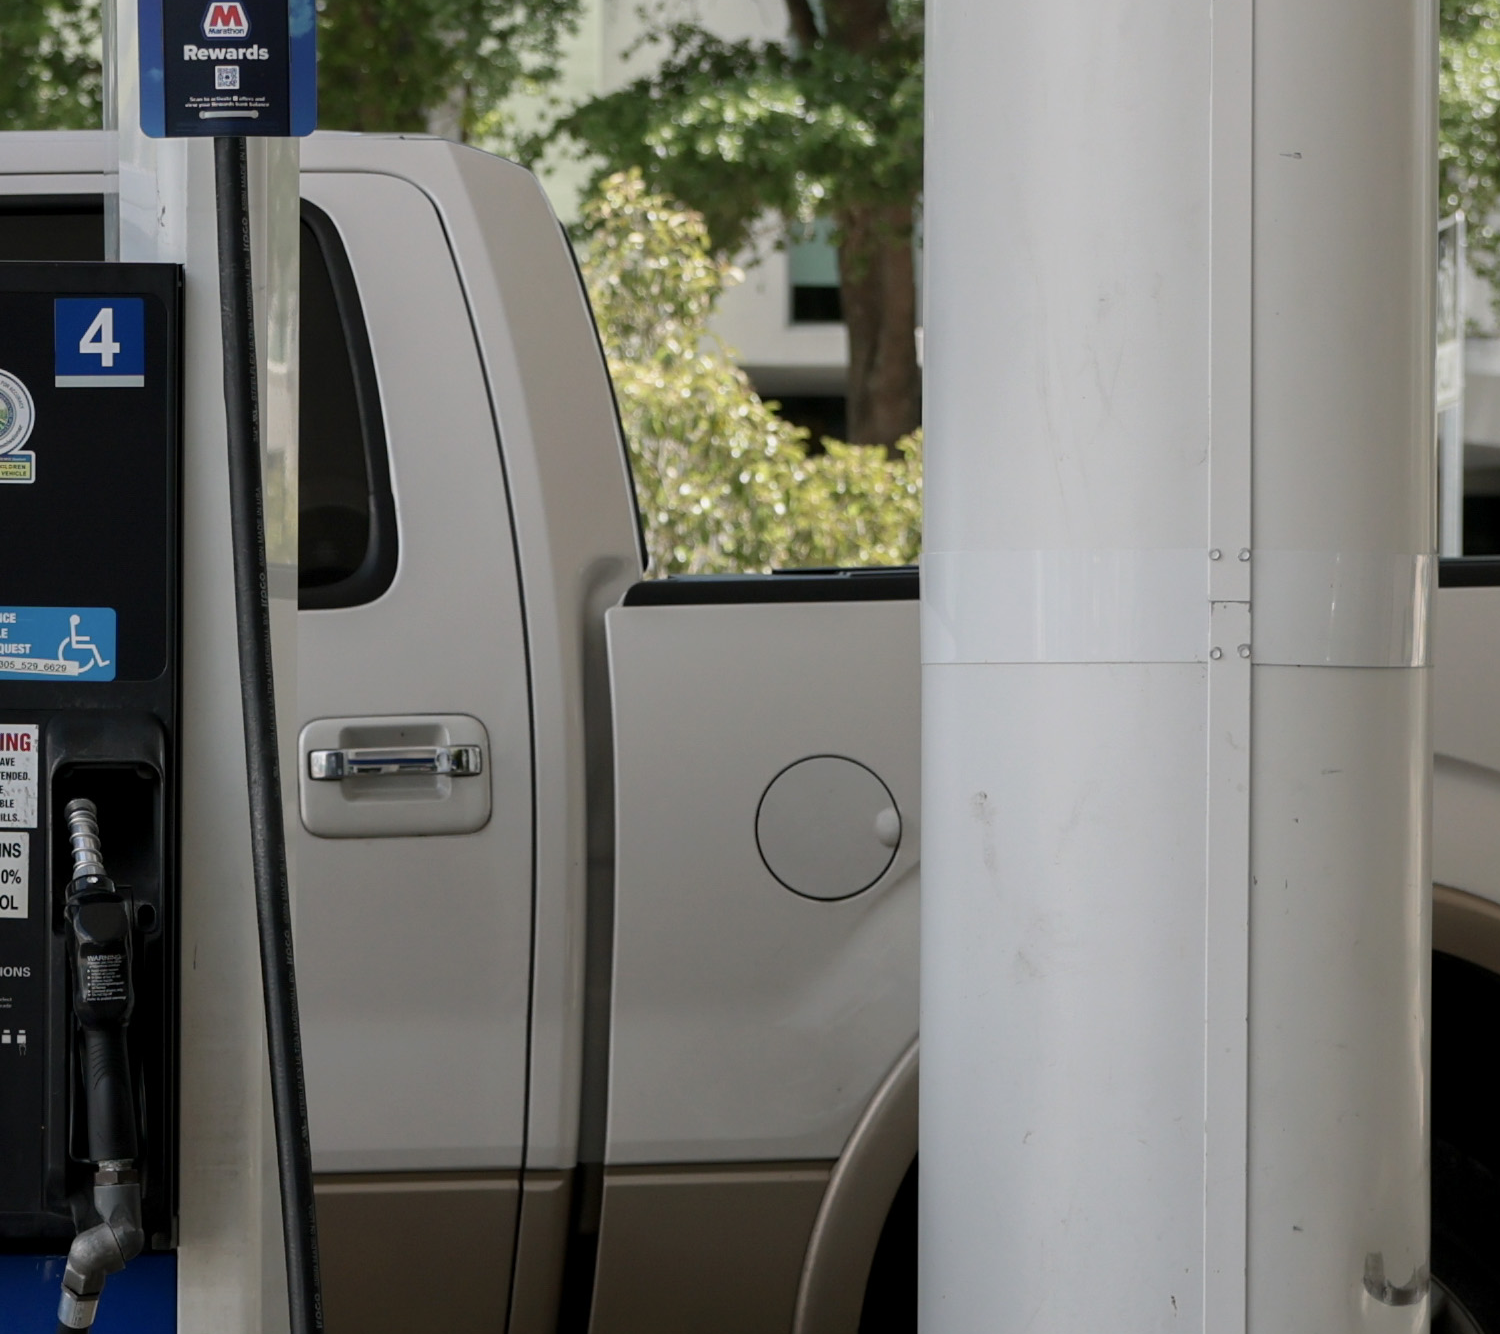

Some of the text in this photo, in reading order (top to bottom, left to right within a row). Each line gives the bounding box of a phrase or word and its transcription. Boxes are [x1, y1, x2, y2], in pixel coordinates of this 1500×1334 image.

[209, 5, 243, 27] M
[183, 44, 269, 60] Rewards
[79, 308, 120, 367] 4
